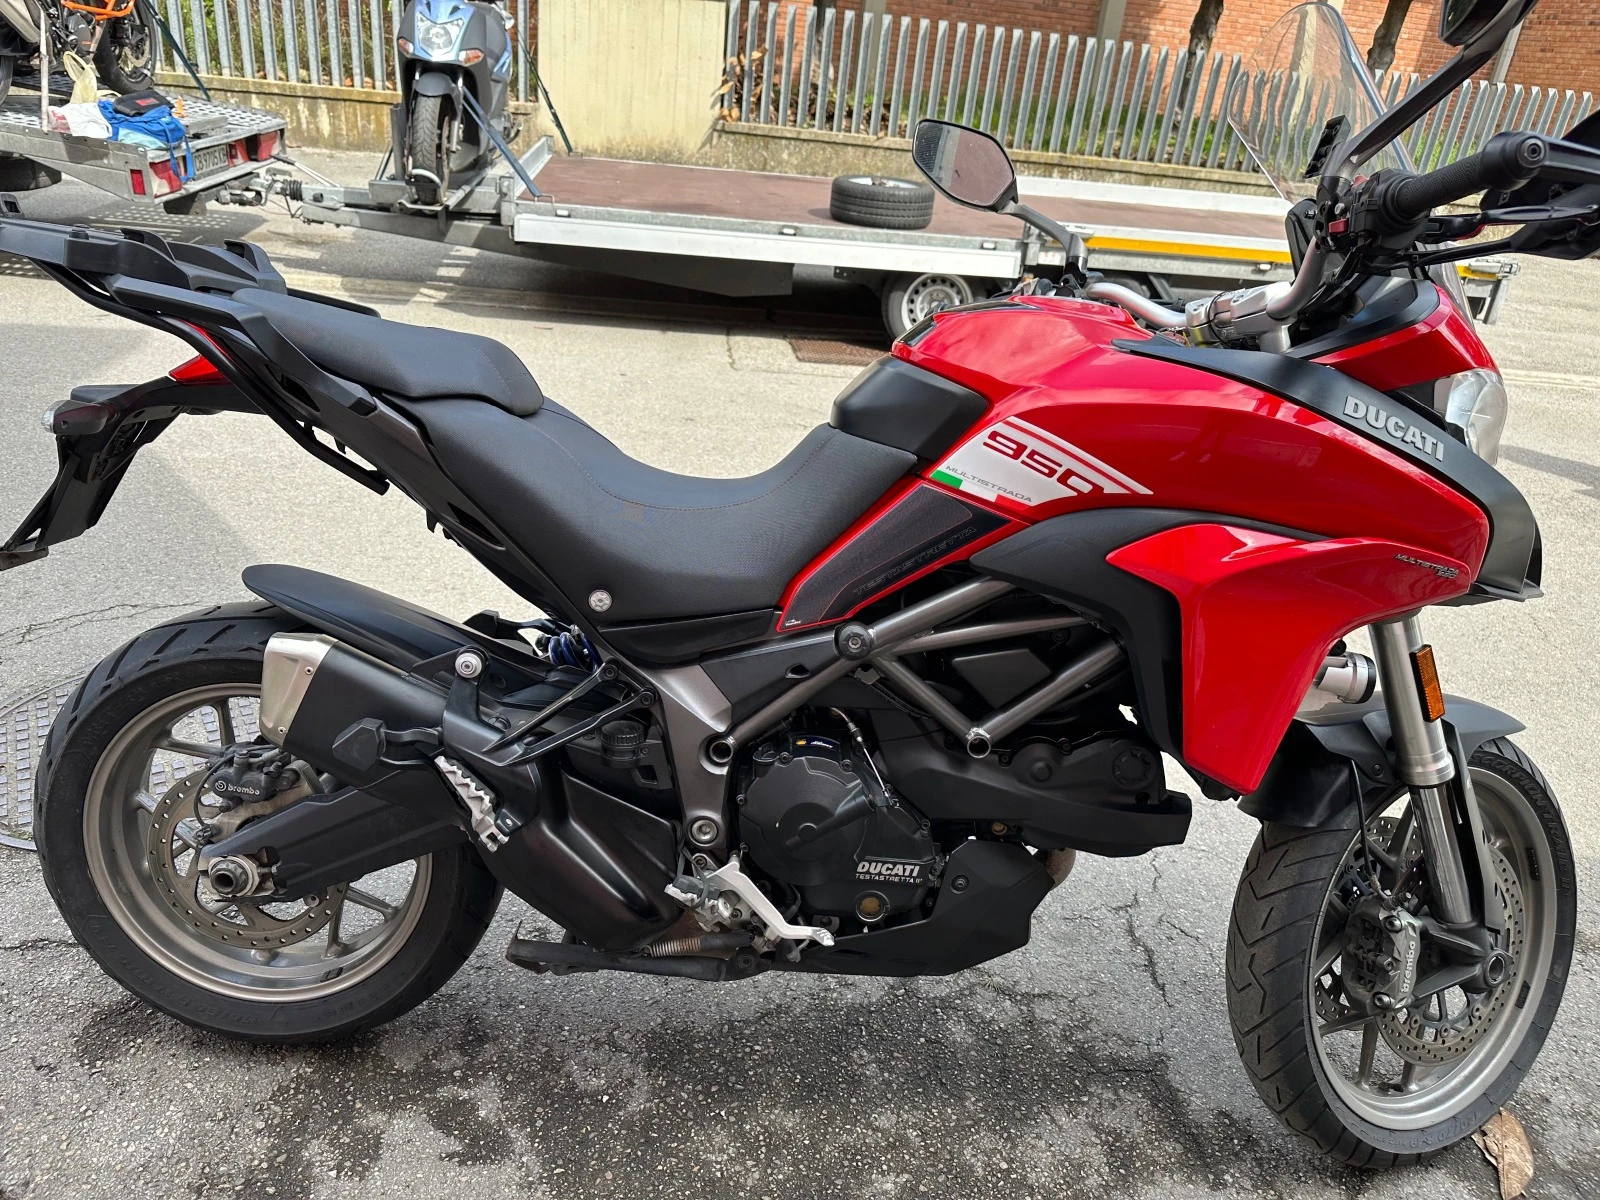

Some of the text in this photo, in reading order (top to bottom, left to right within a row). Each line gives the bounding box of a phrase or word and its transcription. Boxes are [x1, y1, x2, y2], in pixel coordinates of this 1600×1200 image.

[1343, 395, 1444, 462] DUCATI
[945, 465, 1032, 503] MULTISTRADA
[983, 430, 1106, 496] 950
[853, 526, 977, 595] TESTASTRETTA
[227, 783, 260, 796] brembo
[1472, 752, 1547, 807] SCORPION
[855, 873, 914, 884] TESTASTRETTA
[856, 861, 920, 877] DUCATI
[1401, 940, 1416, 993] brembo
